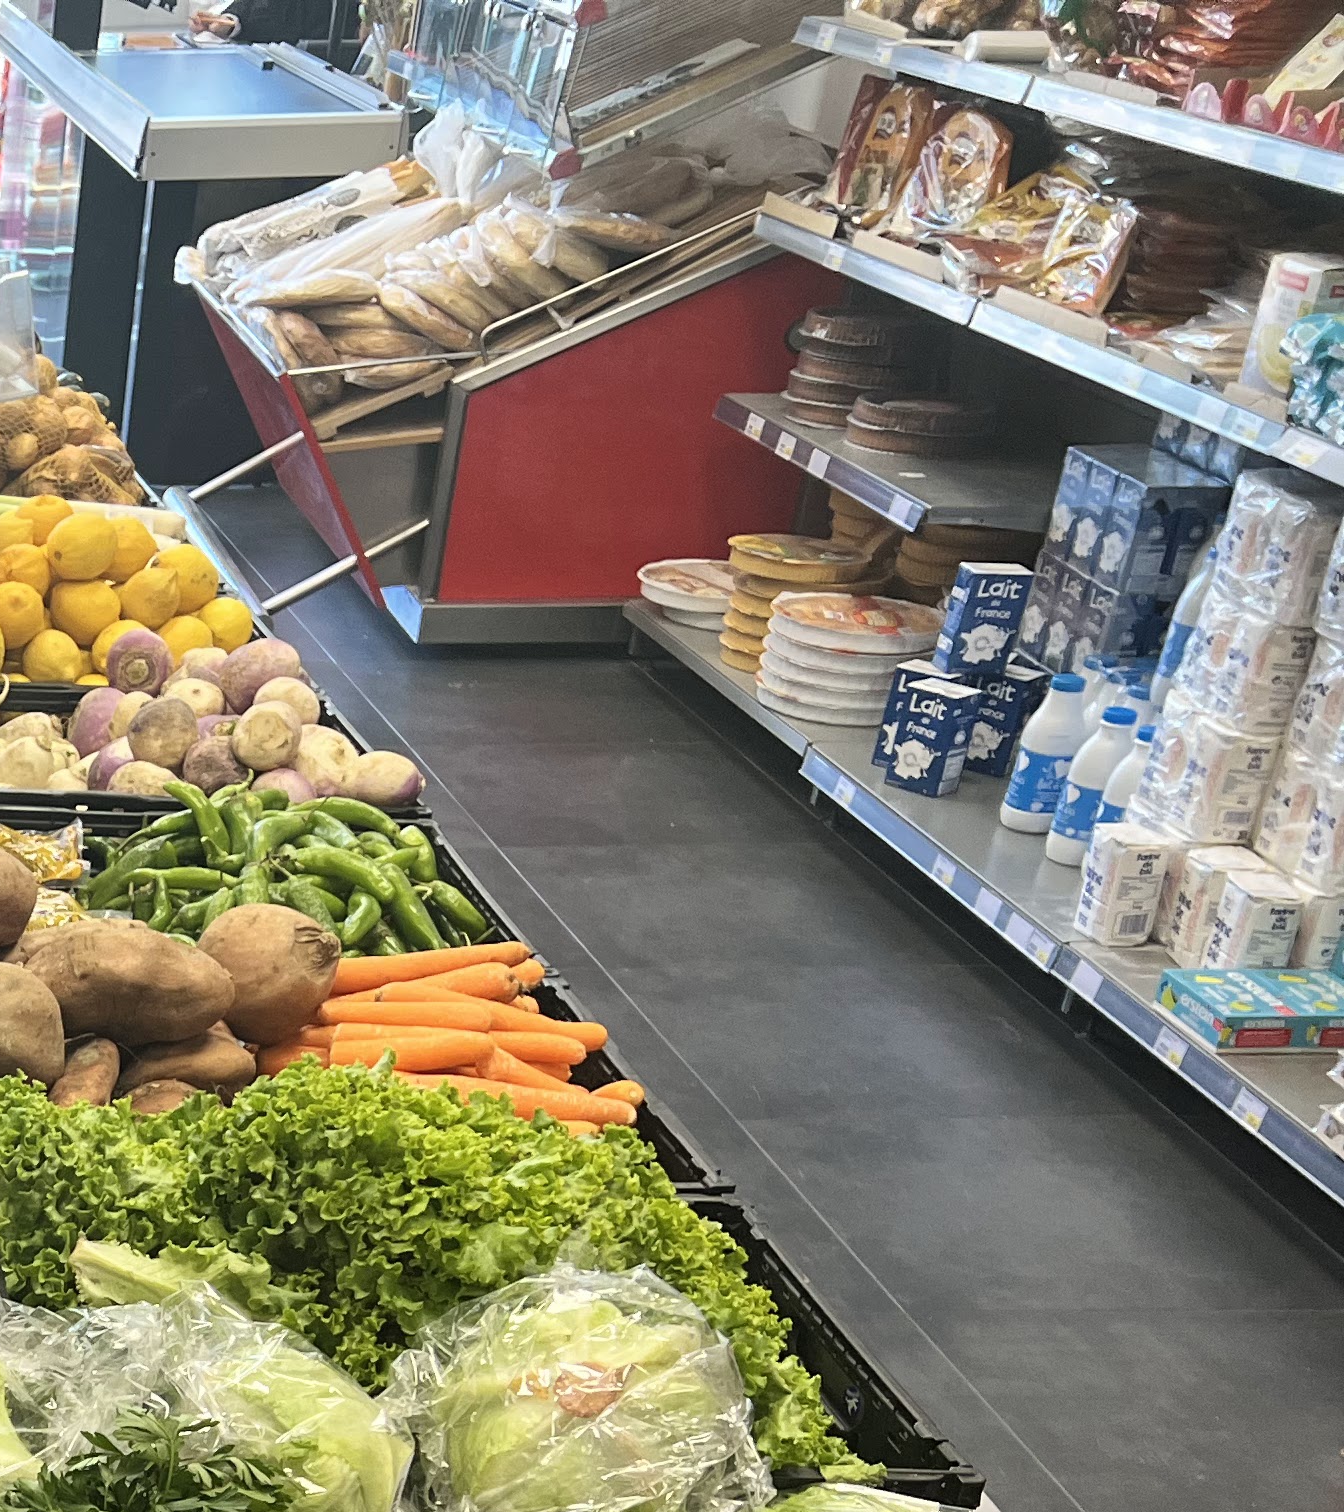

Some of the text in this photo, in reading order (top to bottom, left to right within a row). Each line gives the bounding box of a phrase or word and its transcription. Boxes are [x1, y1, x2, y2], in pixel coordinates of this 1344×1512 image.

[977, 578, 1024, 600] Lait
[974, 607, 1012, 620] France
[909, 693, 948, 721] Lait
[906, 722, 938, 741] France
